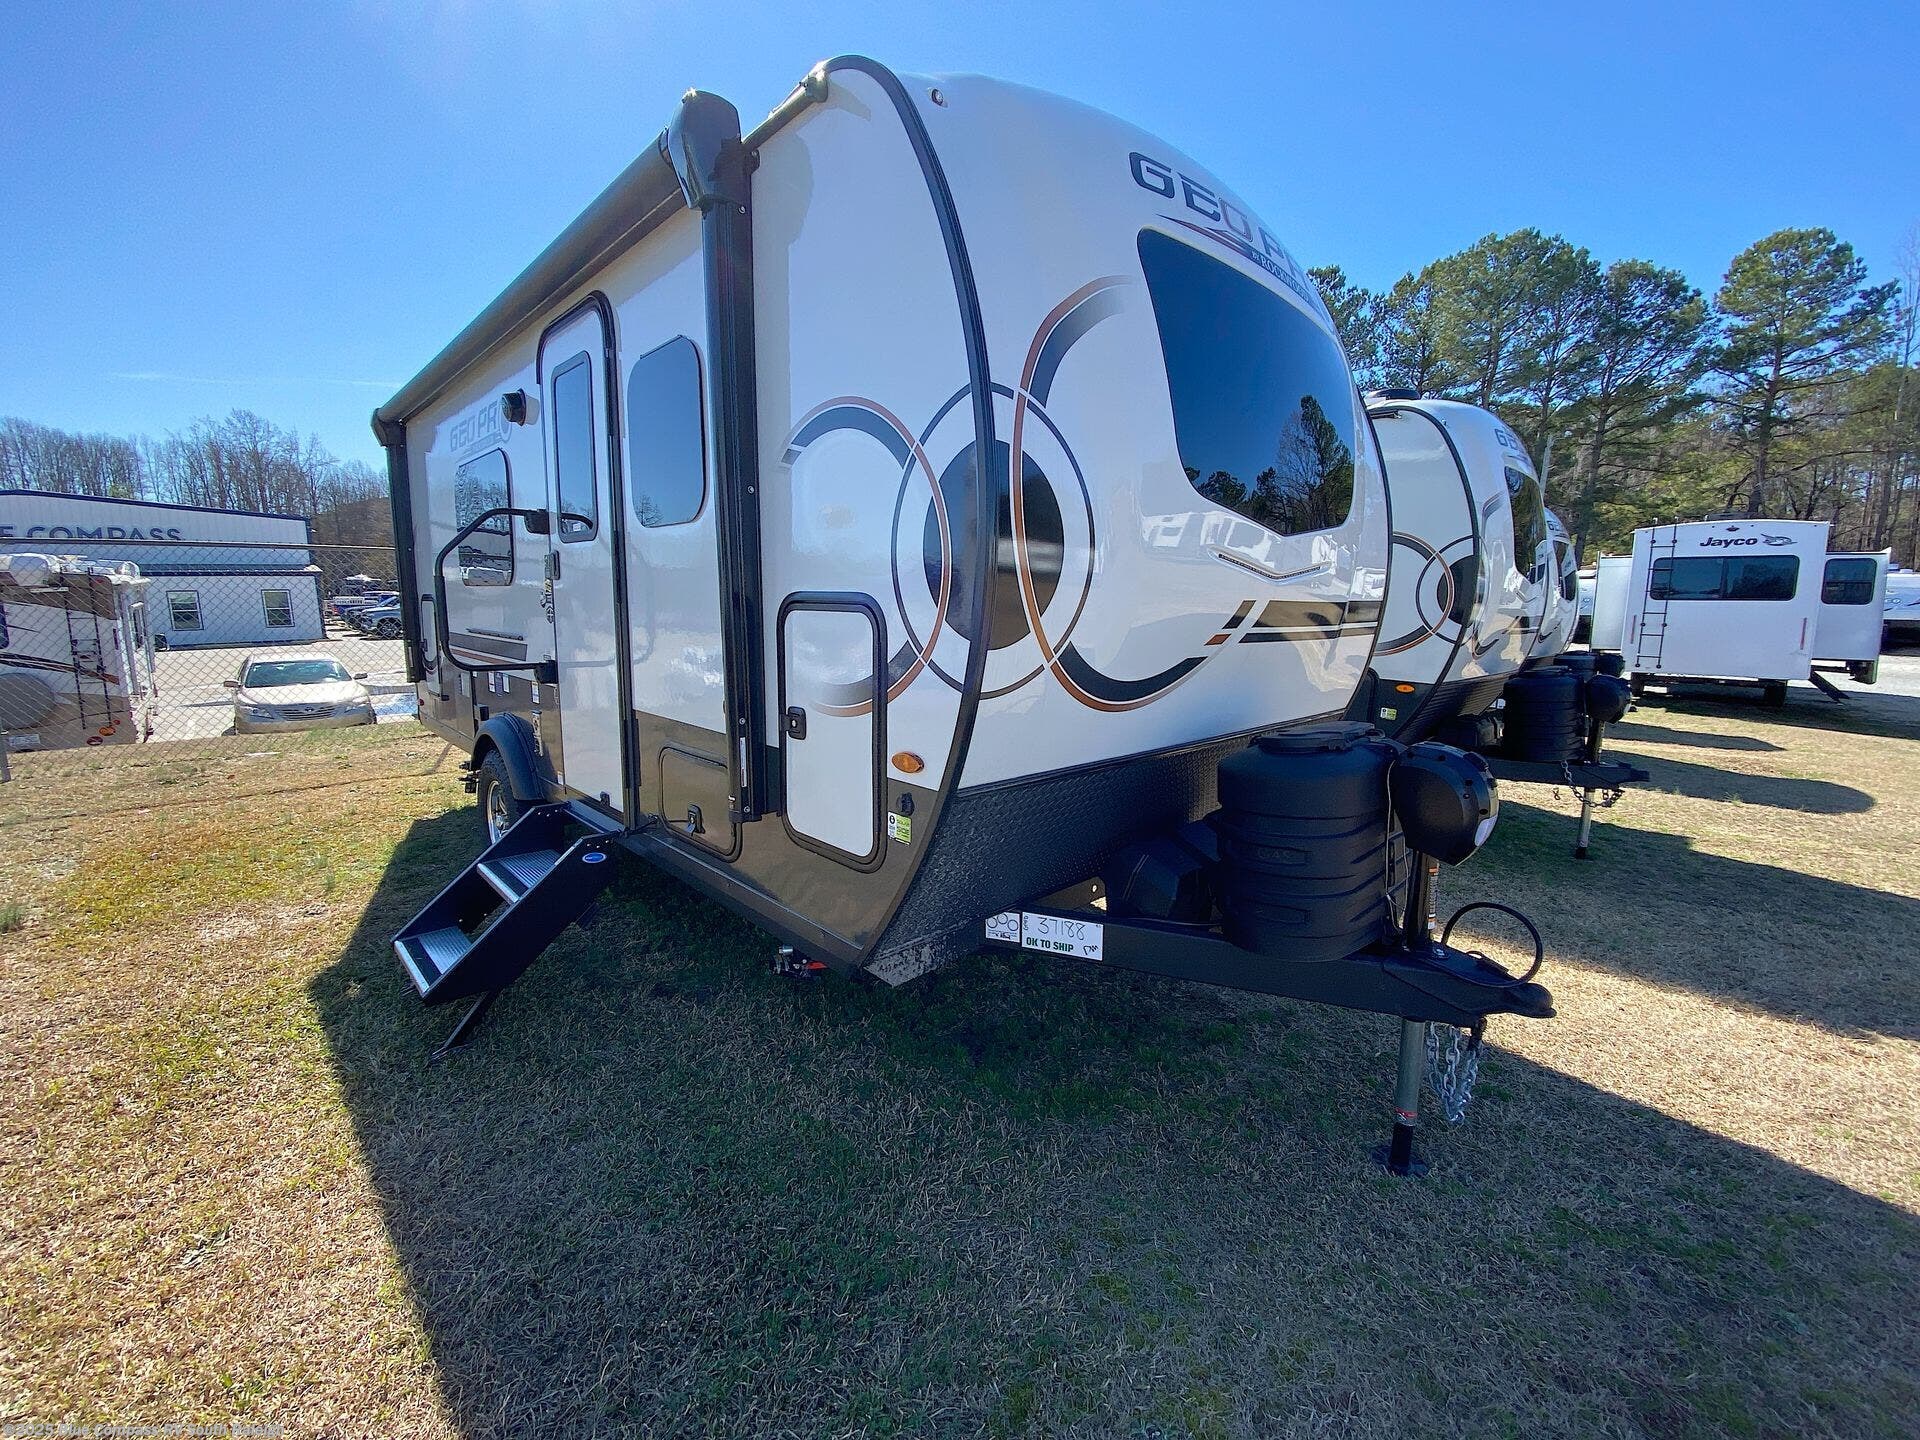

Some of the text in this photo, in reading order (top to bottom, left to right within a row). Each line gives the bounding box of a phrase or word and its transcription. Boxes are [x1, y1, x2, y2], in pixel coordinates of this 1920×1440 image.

[1128, 151, 1253, 243] GEO
[1699, 537, 1758, 548] Jayco
[1026, 936, 1039, 947] OK
[1040, 938, 1051, 949] TO
[1053, 941, 1074, 953] SHIP
